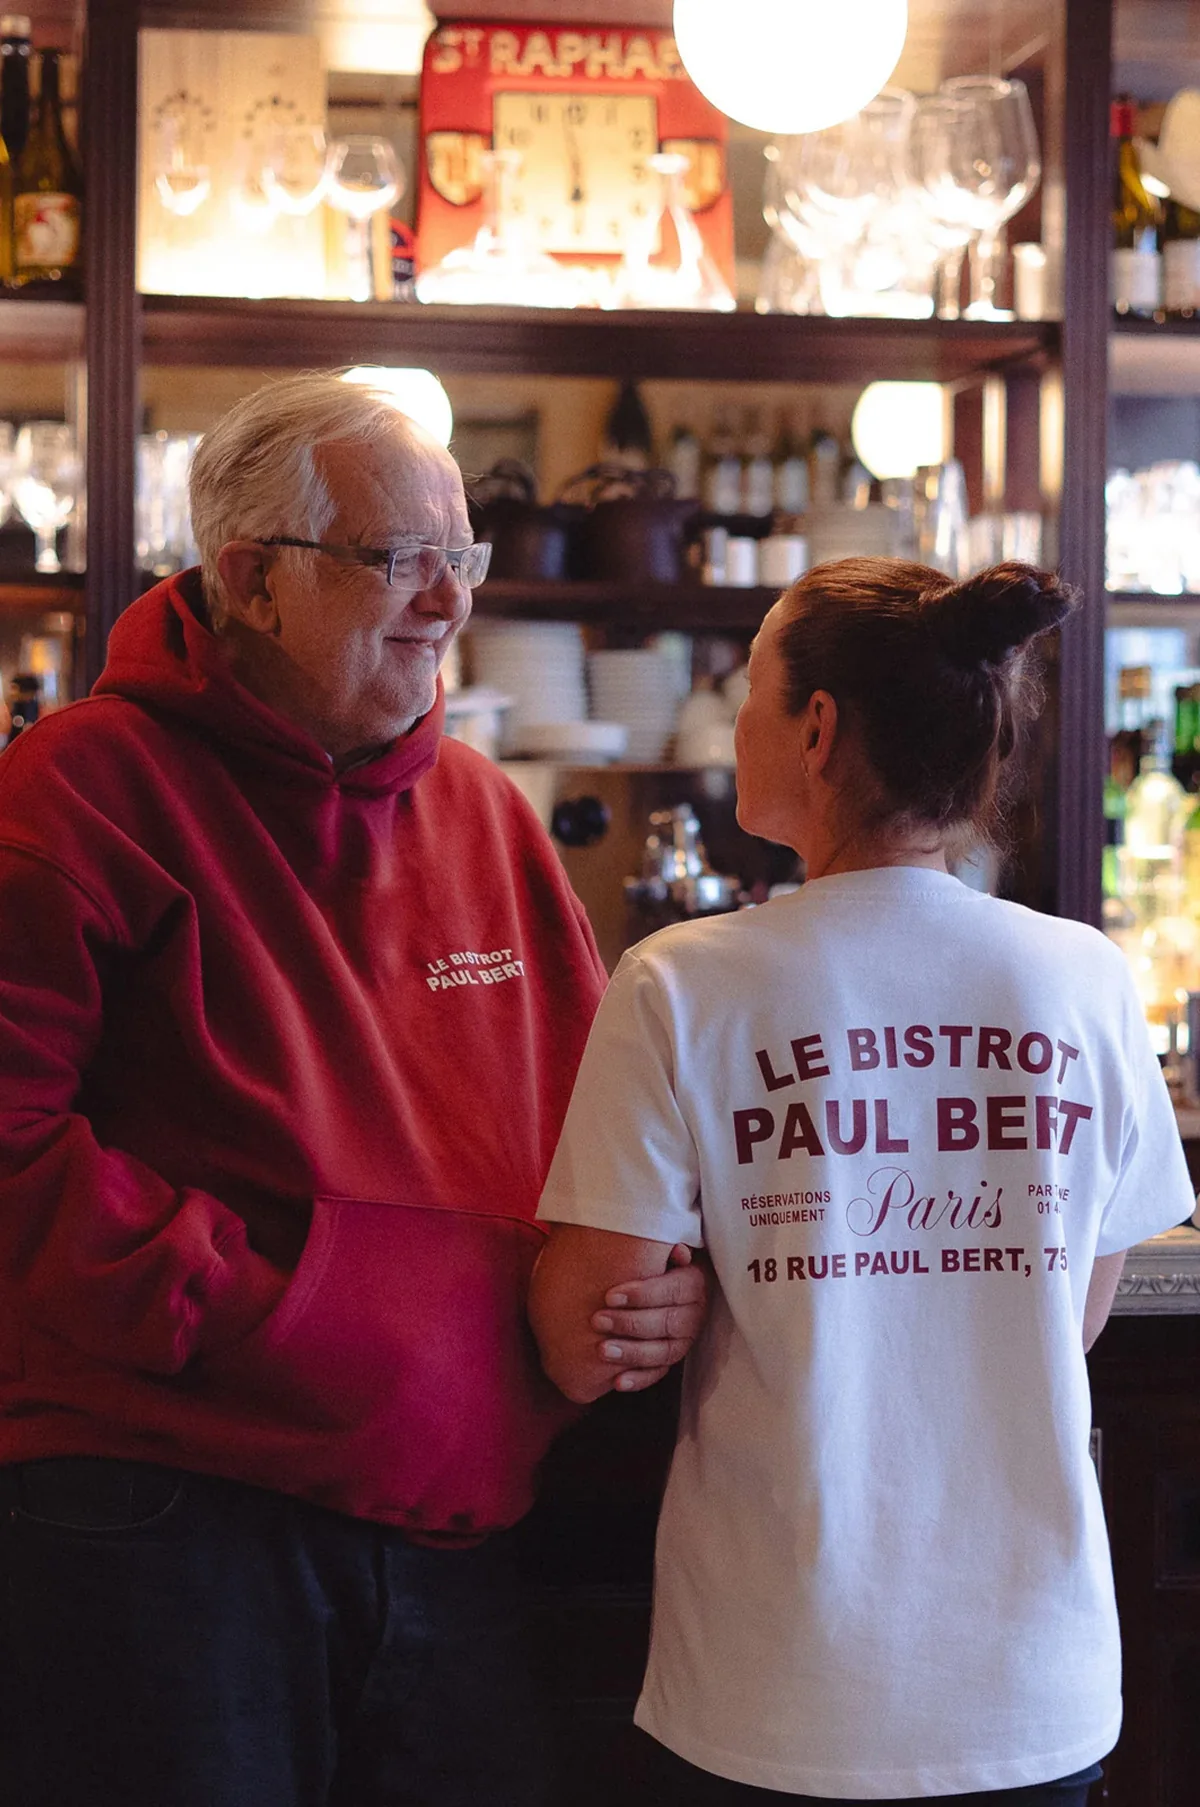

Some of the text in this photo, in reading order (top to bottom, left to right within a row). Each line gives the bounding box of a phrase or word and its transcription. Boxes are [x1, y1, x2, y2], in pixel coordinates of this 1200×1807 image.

[426, 960, 525, 992] PAUL BERT
[427, 949, 512, 975] LE BISTROT
[755, 1025, 1080, 1092] LE BISTROT
[733, 1096, 1093, 1165] PAUL BERT
[741, 1190, 832, 1211] RÉSERVATIONS
[846, 1166, 1004, 1237] Paris
[749, 1208, 826, 1227] UNIQUEMENT
[747, 1258, 777, 1283] 18
[787, 1254, 847, 1281] RUE
[855, 1250, 929, 1276] PAUL
[941, 1248, 1032, 1277] BERT,
